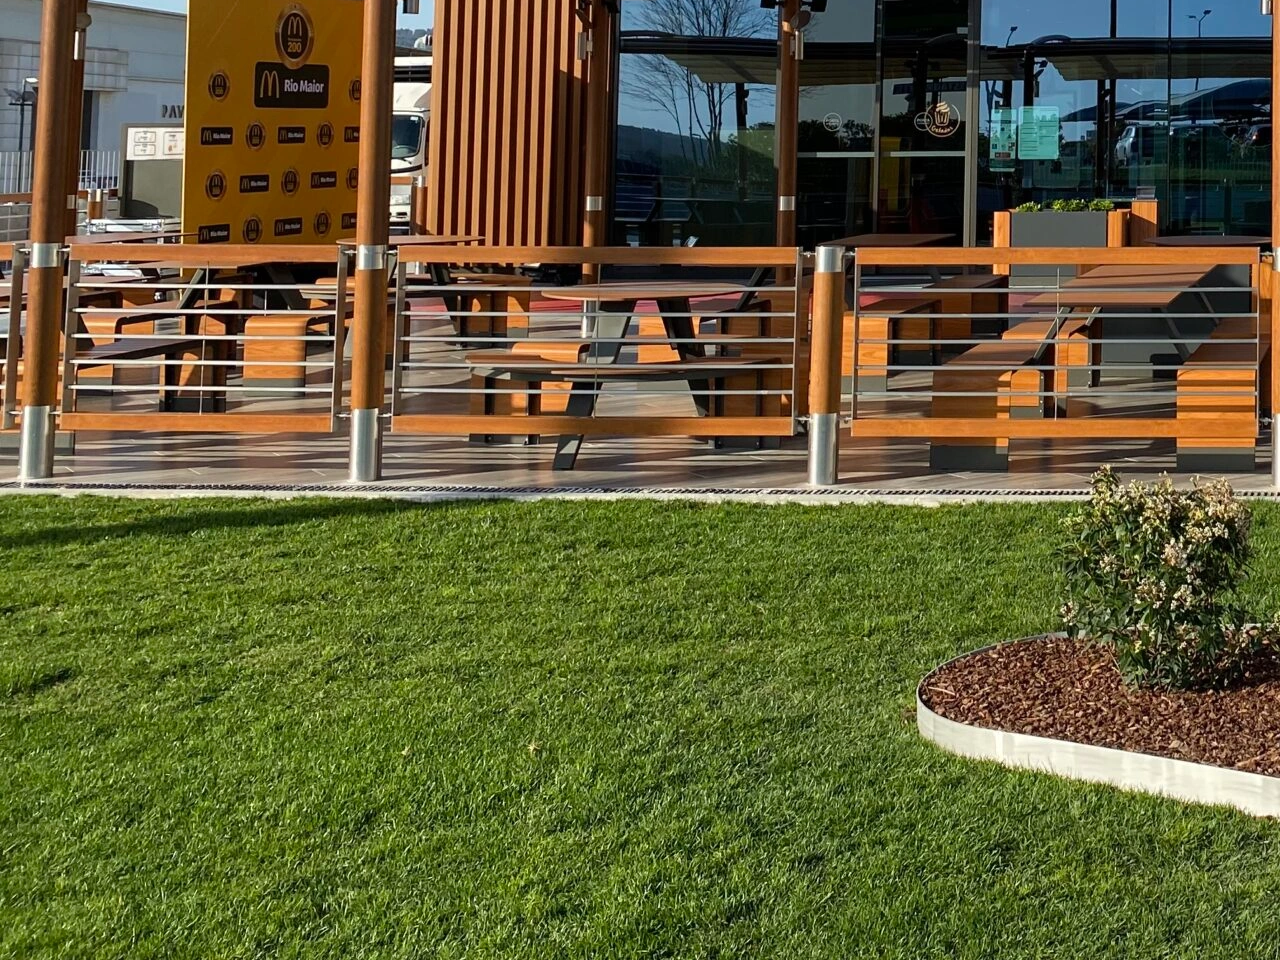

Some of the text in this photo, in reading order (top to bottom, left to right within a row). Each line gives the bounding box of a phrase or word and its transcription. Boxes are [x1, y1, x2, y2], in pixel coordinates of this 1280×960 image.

[287, 41, 302, 53] 200
[284, 78, 324, 93] Rio Maior
